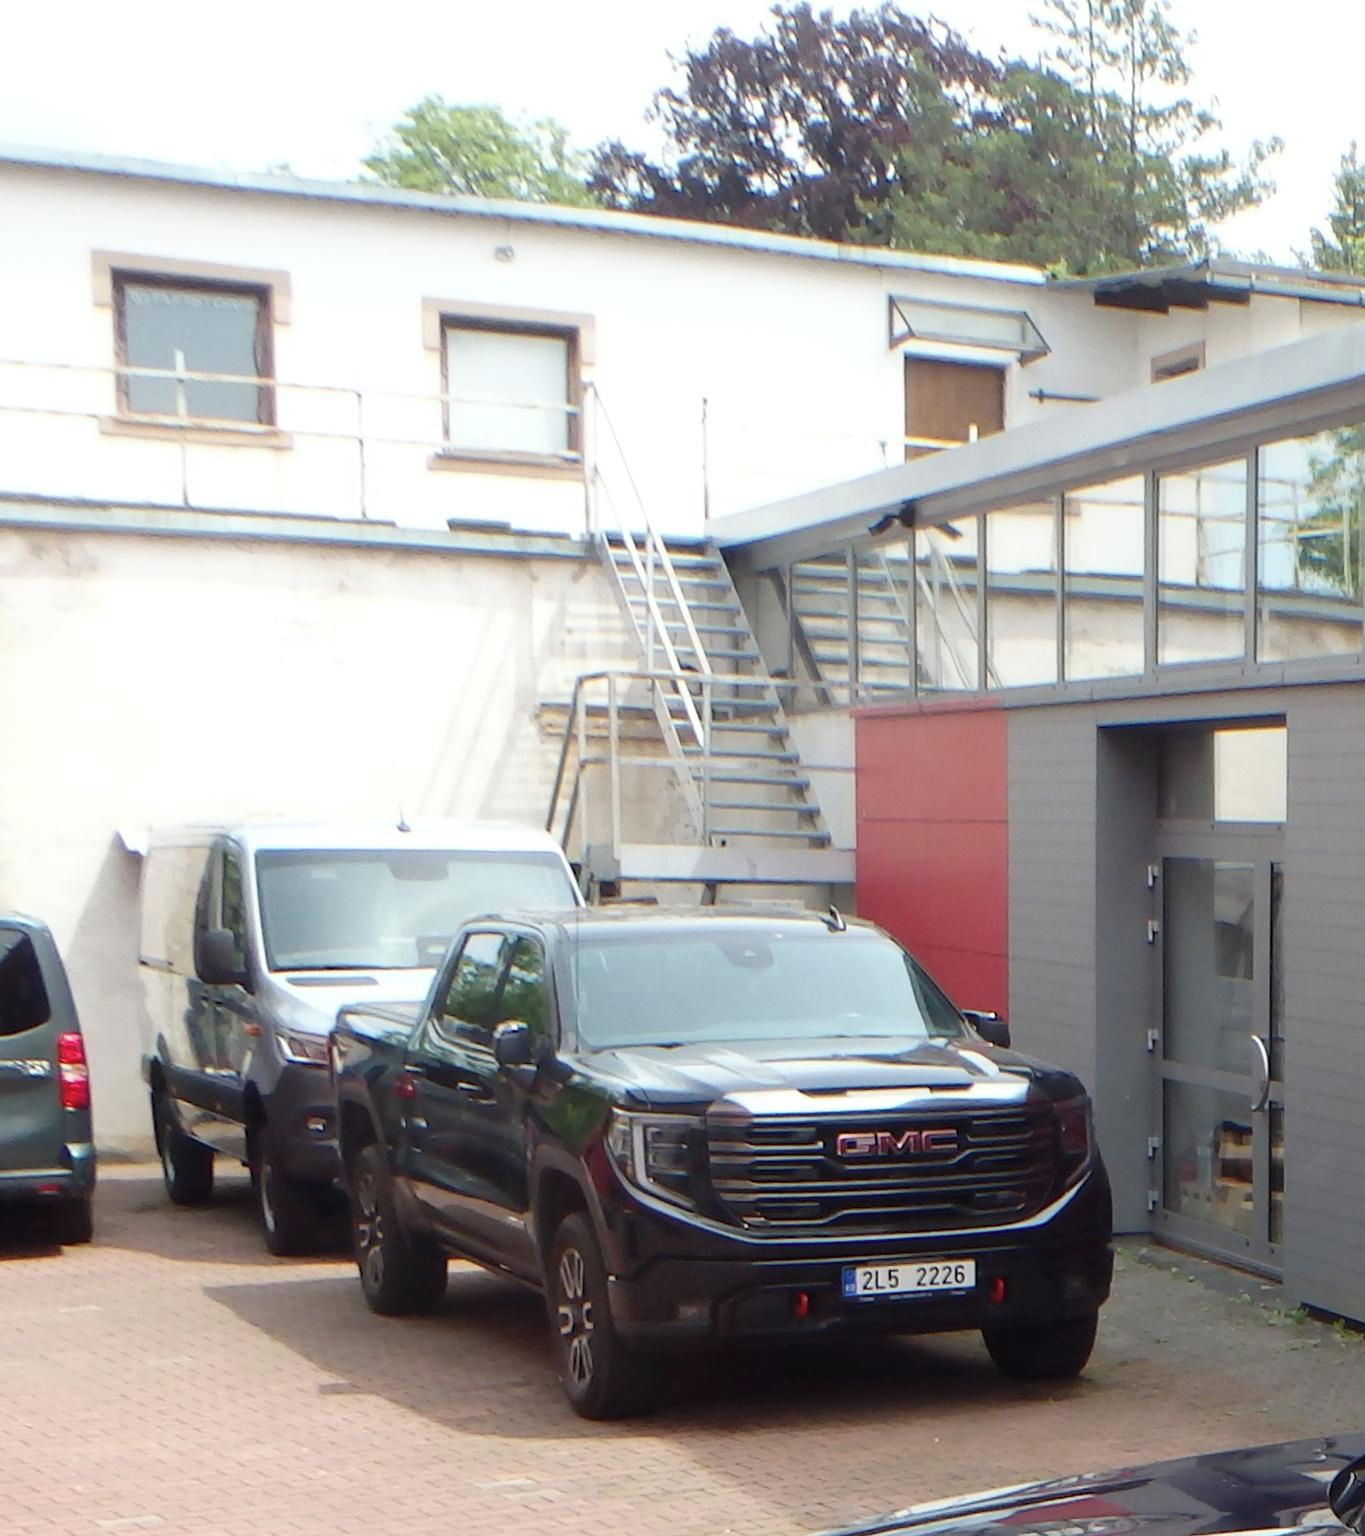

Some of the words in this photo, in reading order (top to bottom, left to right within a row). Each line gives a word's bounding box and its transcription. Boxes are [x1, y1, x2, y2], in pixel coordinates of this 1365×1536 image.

[836, 1128, 958, 1157] GMC
[862, 1268, 900, 1291] 2L5
[916, 1264, 966, 1287] 2226
